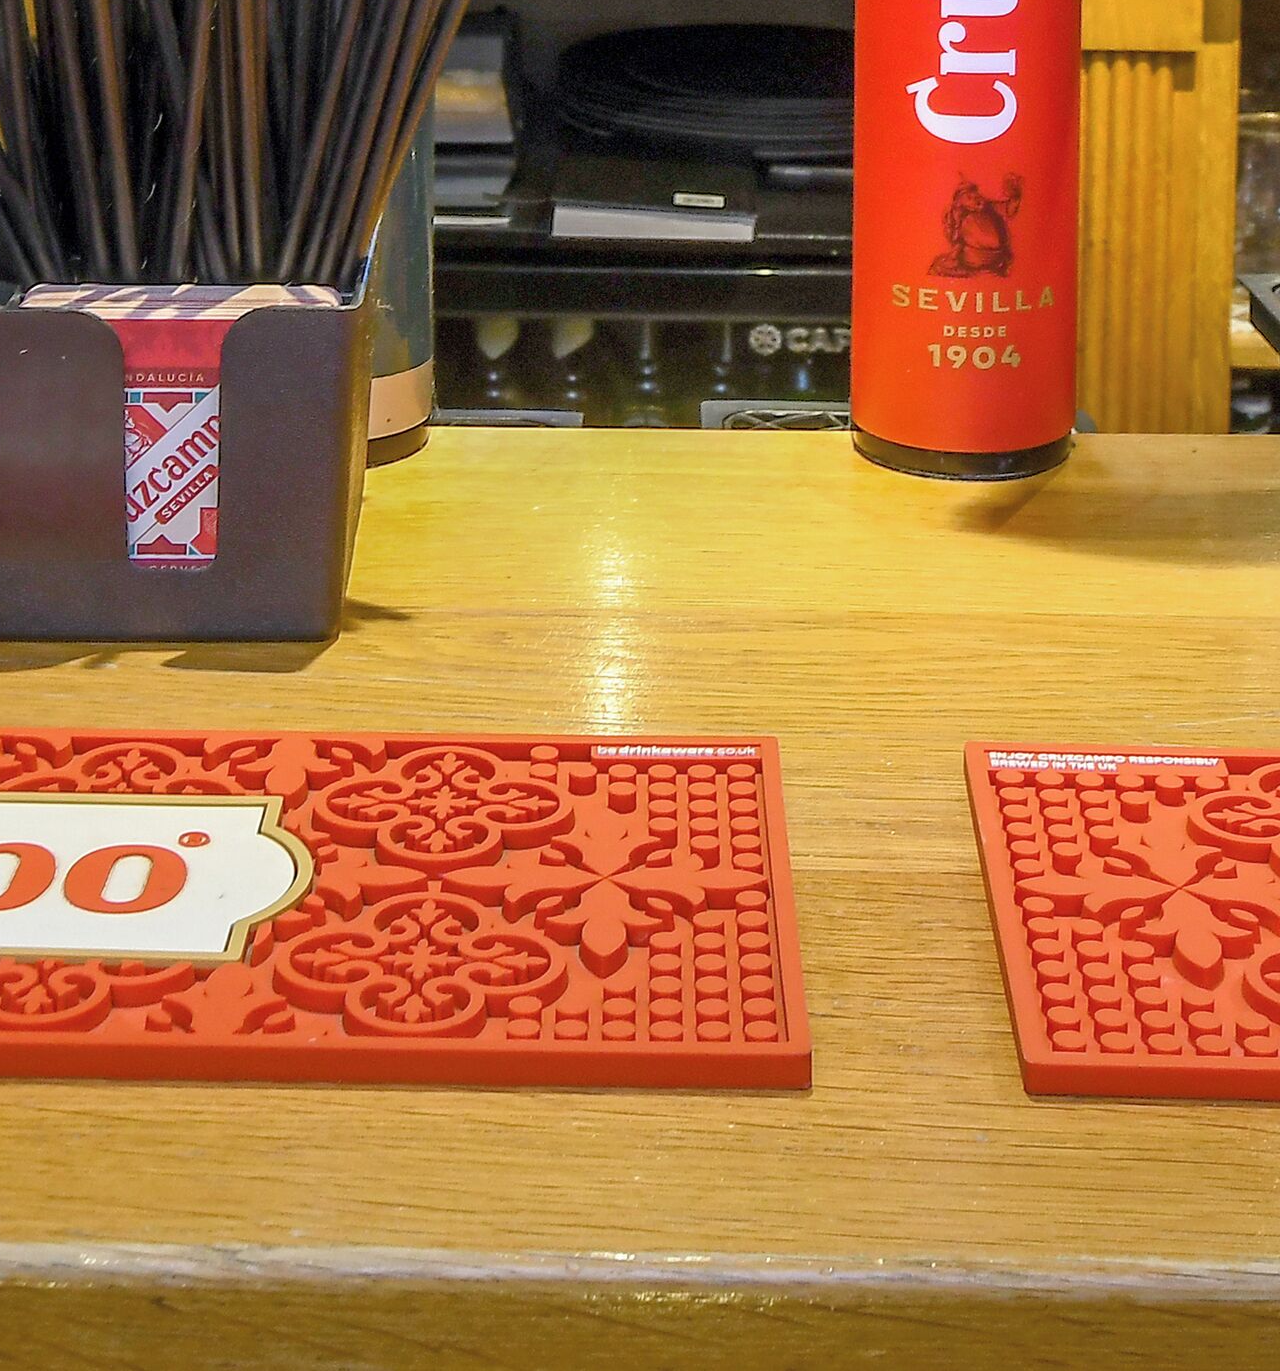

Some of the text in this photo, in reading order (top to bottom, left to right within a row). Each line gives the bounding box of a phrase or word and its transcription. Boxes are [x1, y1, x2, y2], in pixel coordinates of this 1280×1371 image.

[891, 283, 1055, 313] SEVILLA
[942, 325, 1008, 339] DESDE
[927, 343, 1022, 370] 1904
[124, 371, 205, 383] NDALUCÍA
[158, 470, 215, 520] SEVILLA
[597, 744, 757, 757] be drinkaware.co.uk
[988, 750, 1220, 767] ENJOY CRUZCAMPO RESPONSIBLY
[990, 759, 1118, 772] BREWED IN THE UK
